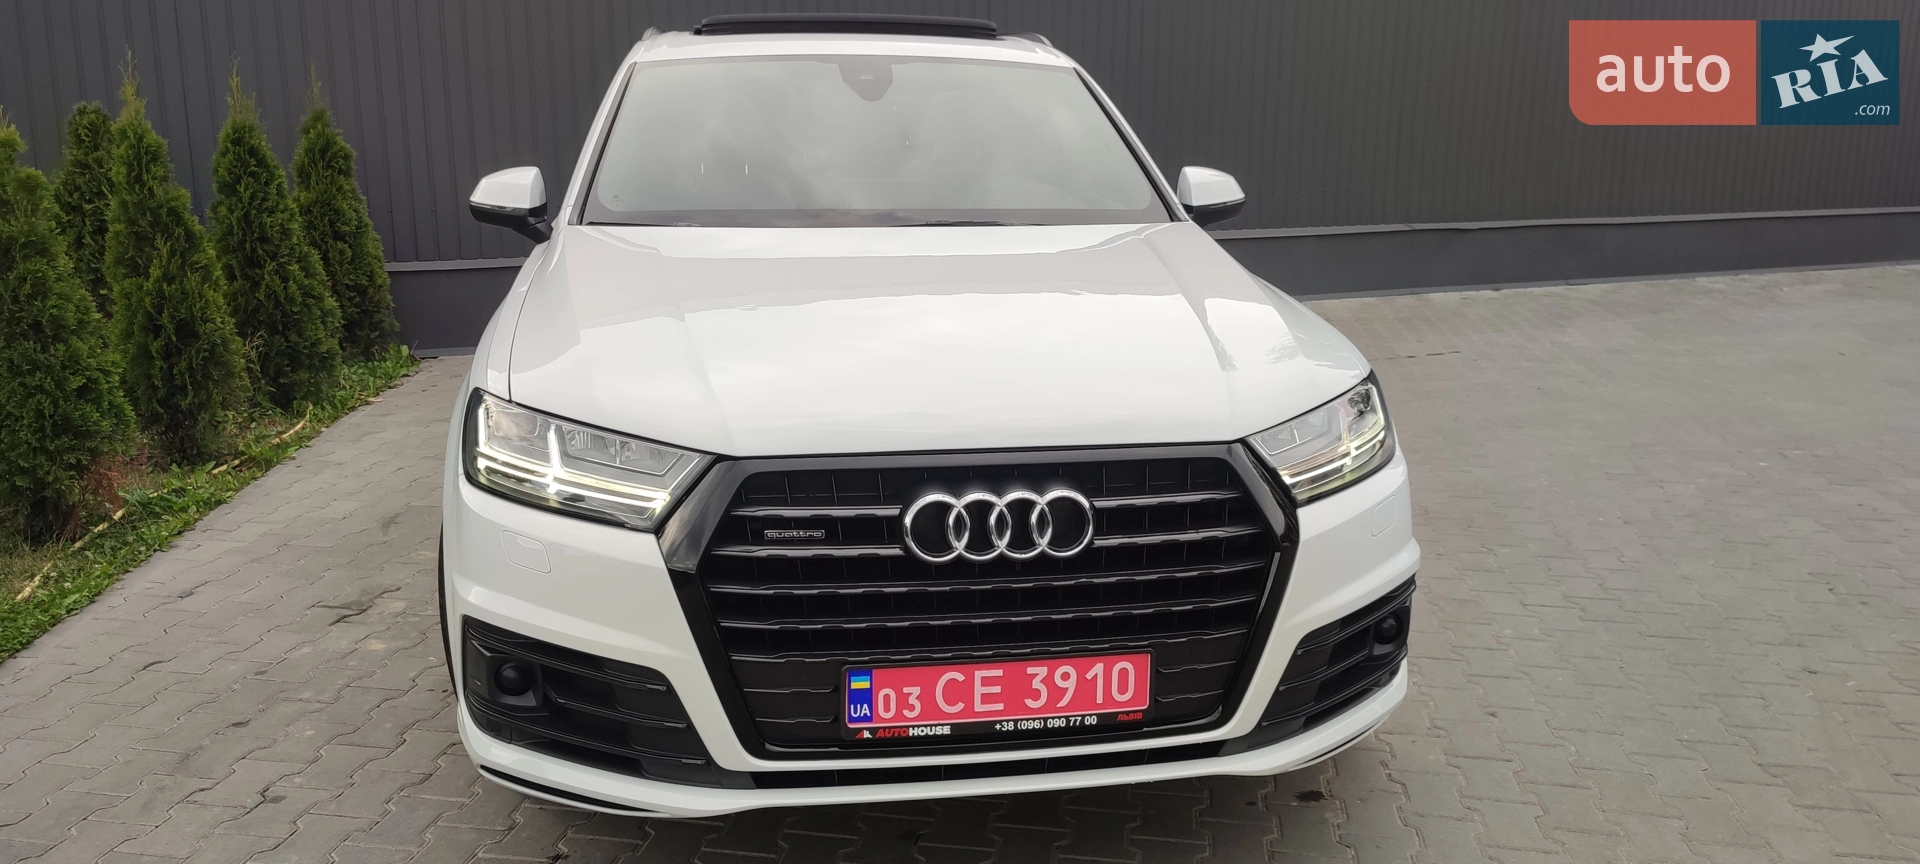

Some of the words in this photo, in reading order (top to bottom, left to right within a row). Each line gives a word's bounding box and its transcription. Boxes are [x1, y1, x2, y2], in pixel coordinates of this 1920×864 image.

[767, 531, 822, 539] quattro
[877, 686, 922, 719] 03
[935, 669, 1005, 714] CE
[1023, 661, 1136, 709] 3910
[850, 703, 871, 718] UA
[994, 722, 1015, 731] +38
[1017, 719, 1044, 730] (096)
[1047, 718, 1066, 728] 090
[1069, 716, 1082, 726] 77
[1084, 715, 1098, 725] 00
[875, 725, 951, 737] AUTOHOUSE
